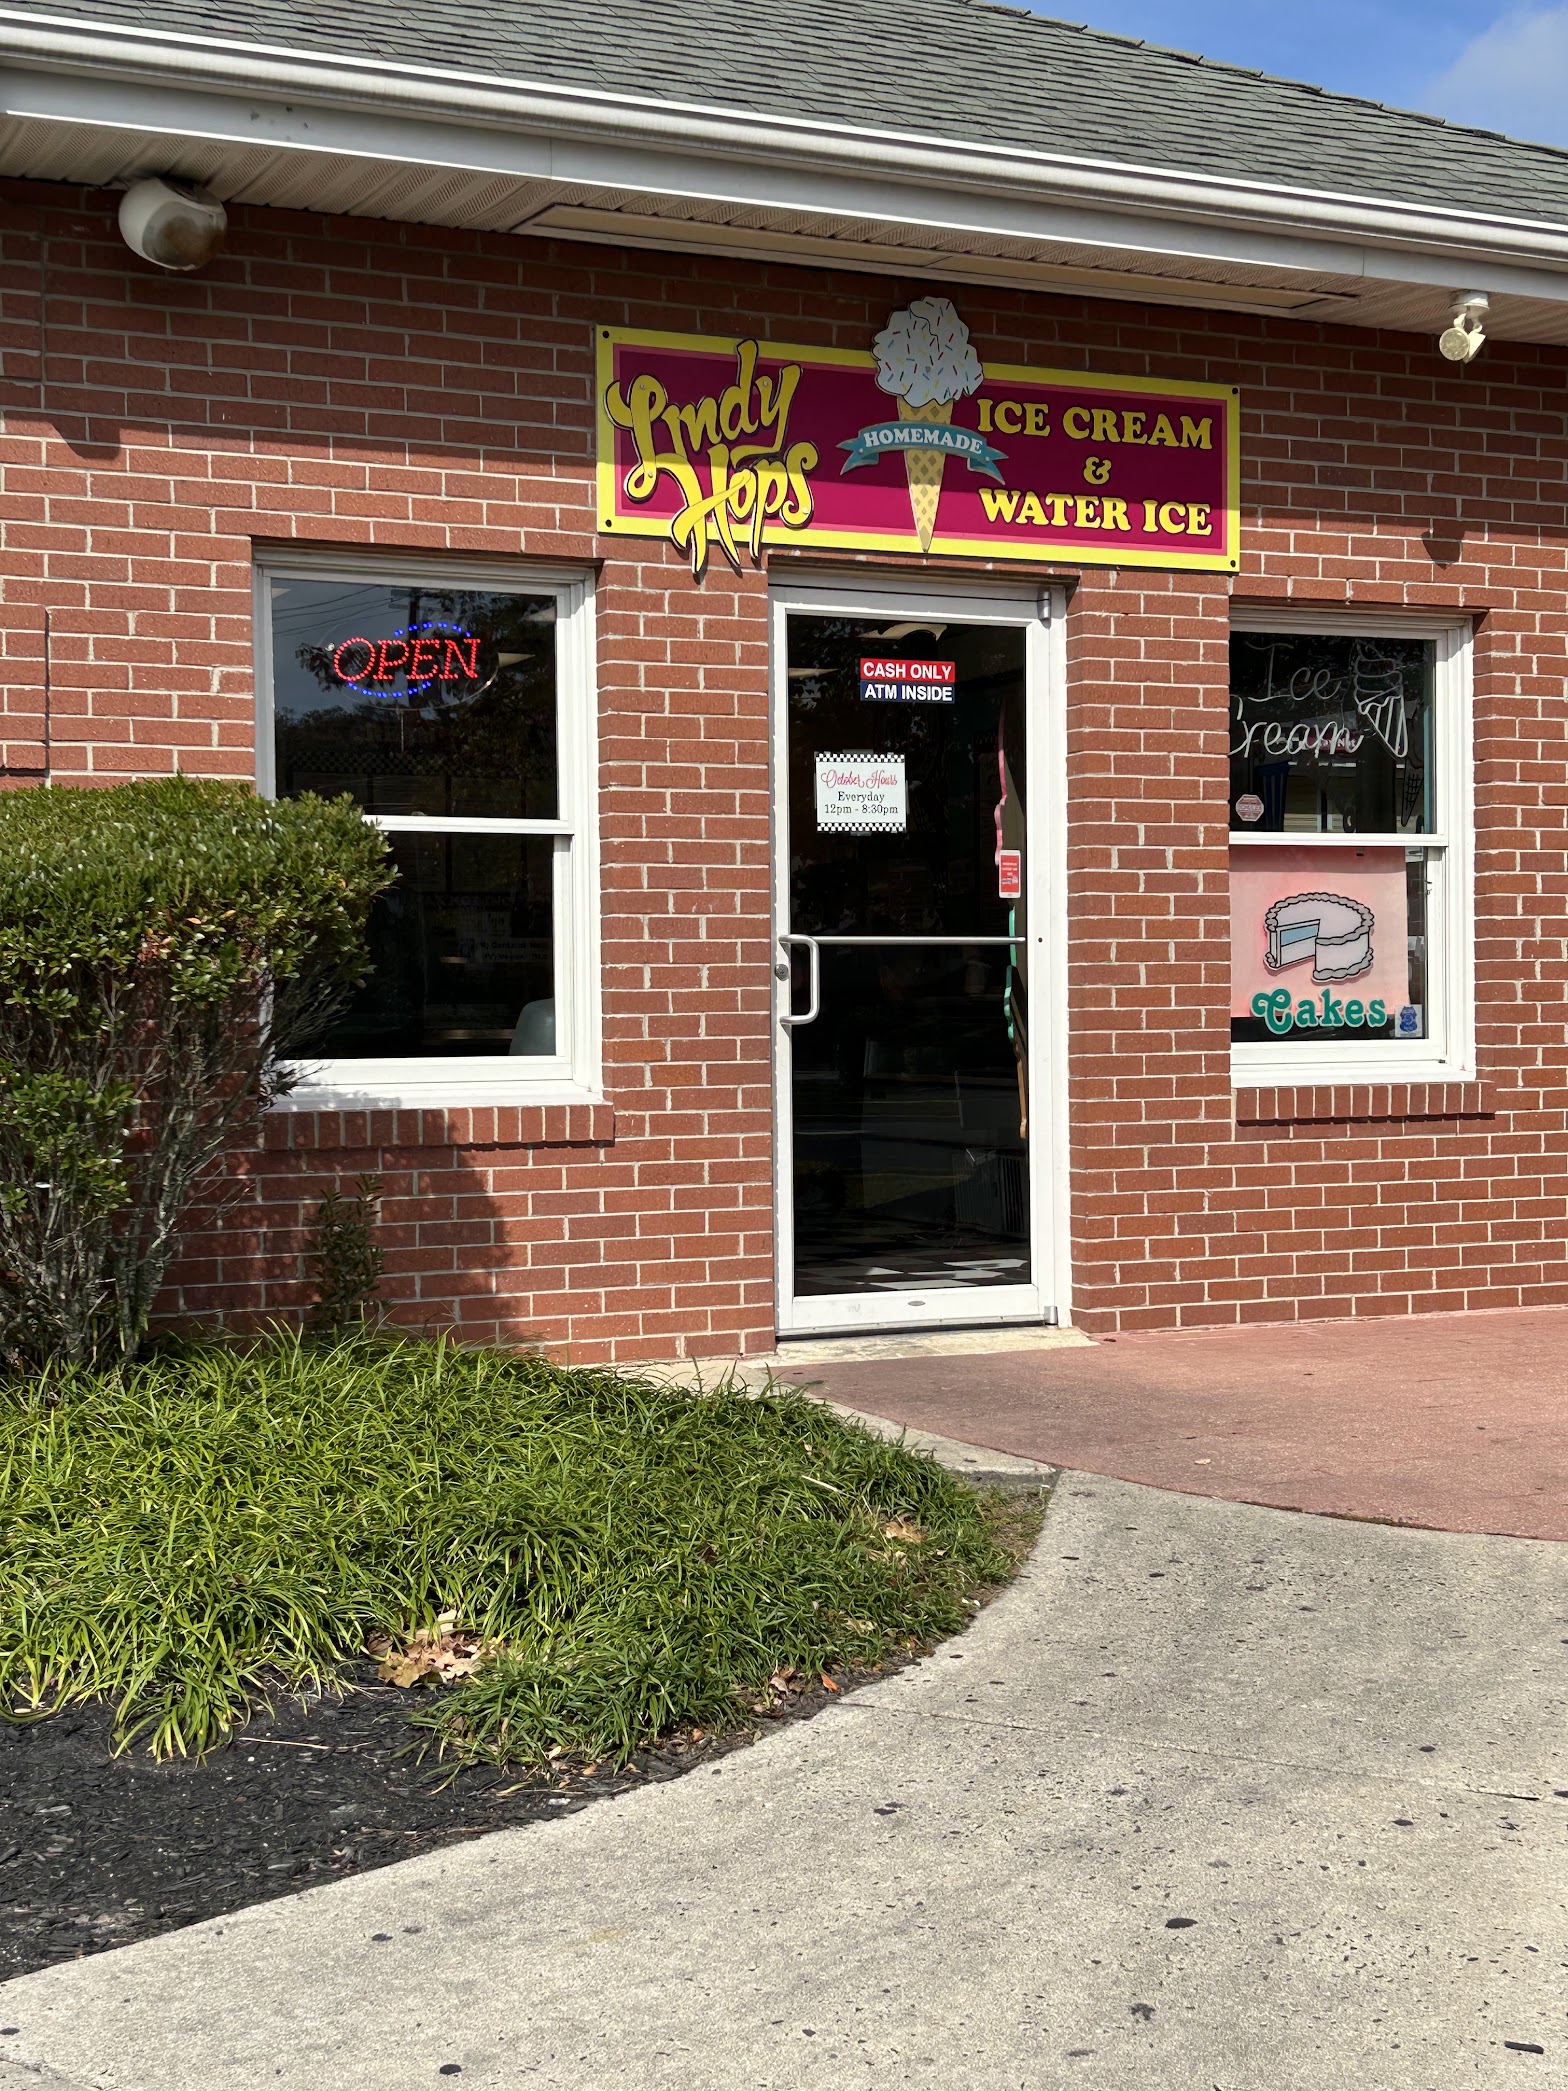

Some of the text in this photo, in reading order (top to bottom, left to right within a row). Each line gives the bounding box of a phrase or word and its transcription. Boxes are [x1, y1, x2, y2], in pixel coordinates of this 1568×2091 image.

[863, 427, 984, 455] HOMEMADE
[976, 398, 1214, 450] ICE CREAM
[1083, 456, 1112, 485] &
[655, 441, 818, 574] Hops
[978, 487, 1213, 537] WATER ICE
[333, 636, 482, 683] OPEN
[863, 661, 952, 681] CASH ONLY
[1245, 642, 1343, 702] Ice
[864, 683, 953, 702] ATM INSIDE
[1229, 694, 1365, 758] ream
[821, 769, 898, 789] October Hours
[837, 791, 885, 804] Everyday
[824, 804, 852, 816] 12pm
[861, 803, 899, 816] 8:30pm
[1250, 987, 1387, 1036] Cakes
